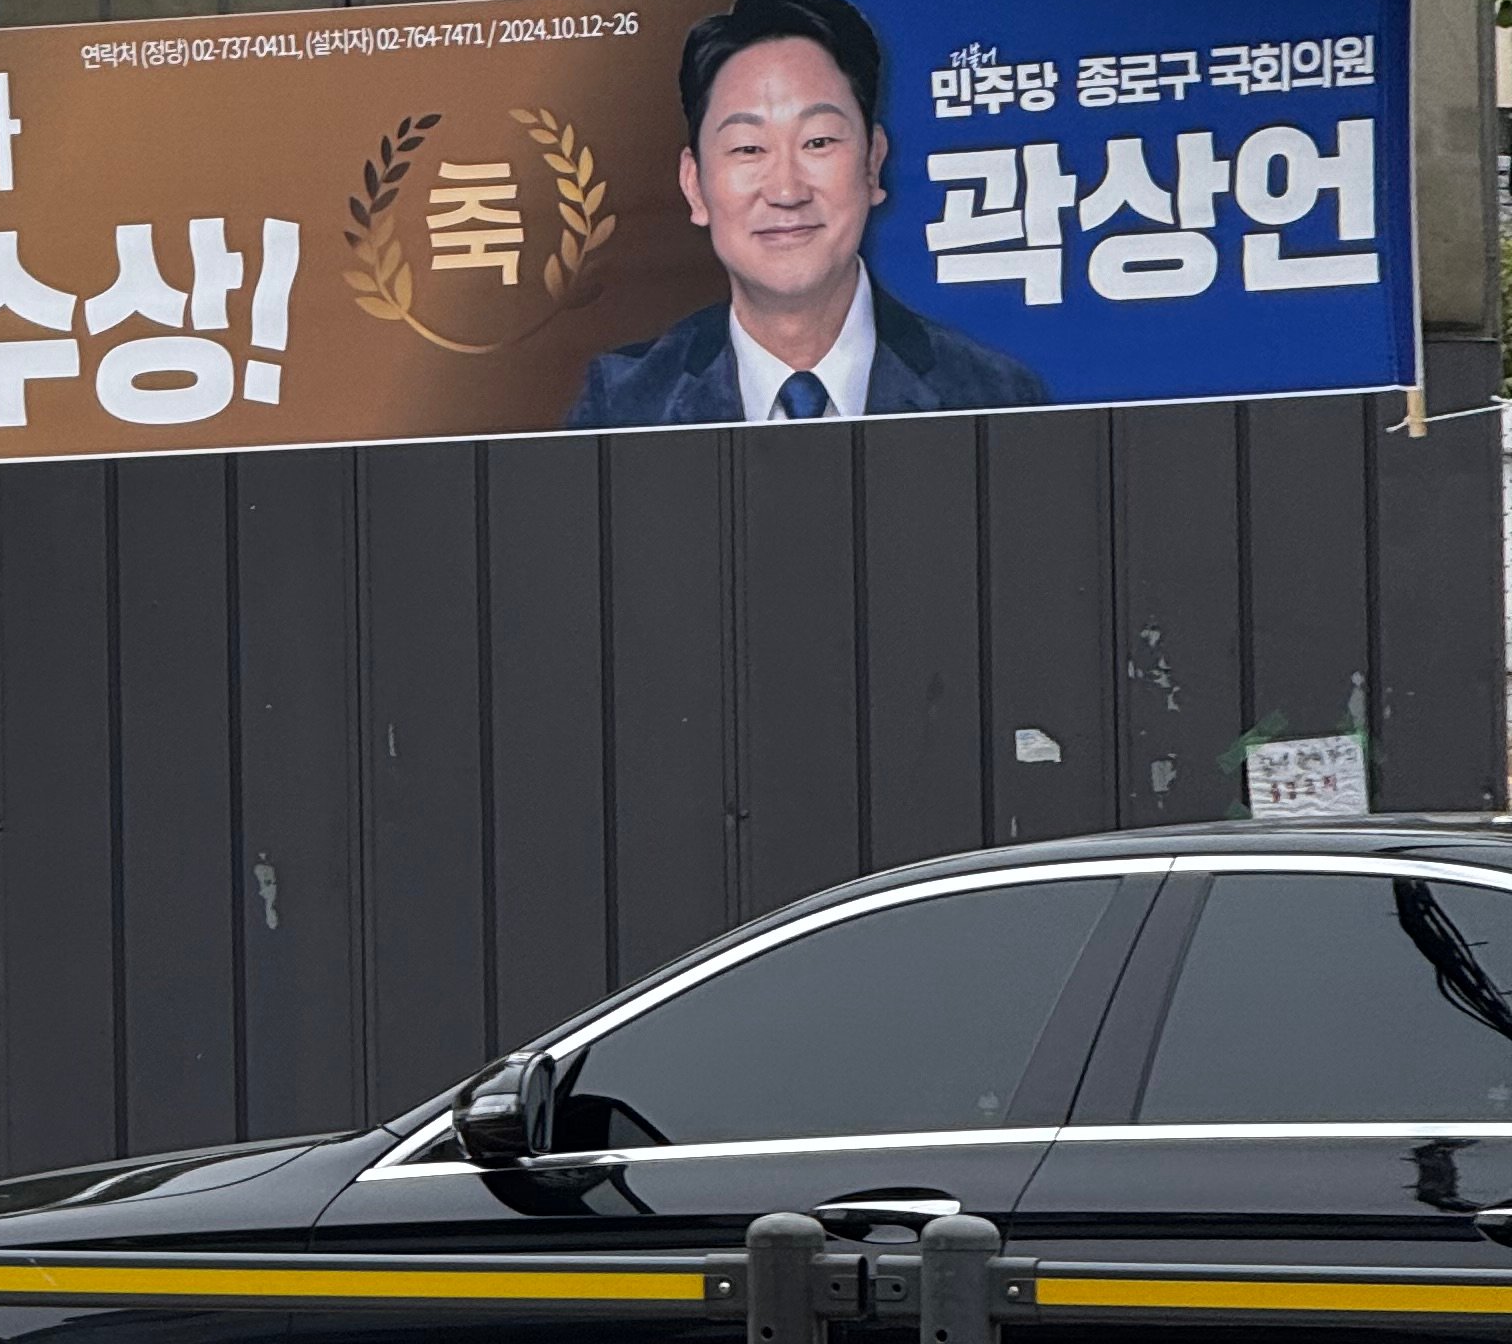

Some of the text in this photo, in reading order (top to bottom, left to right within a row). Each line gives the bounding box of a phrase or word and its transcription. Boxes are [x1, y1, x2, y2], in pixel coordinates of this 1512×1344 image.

[81, 11, 640, 69] 연락처 (정당) 02-737-0411, (설치자) 02-764-7471 / 2024.10.12~26
[931, 35, 1375, 119] 민주당 종로구 국회의원
[949, 41, 997, 71] 더불어
[425, 161, 525, 286] 축
[925, 117, 1381, 306] 곽상언
